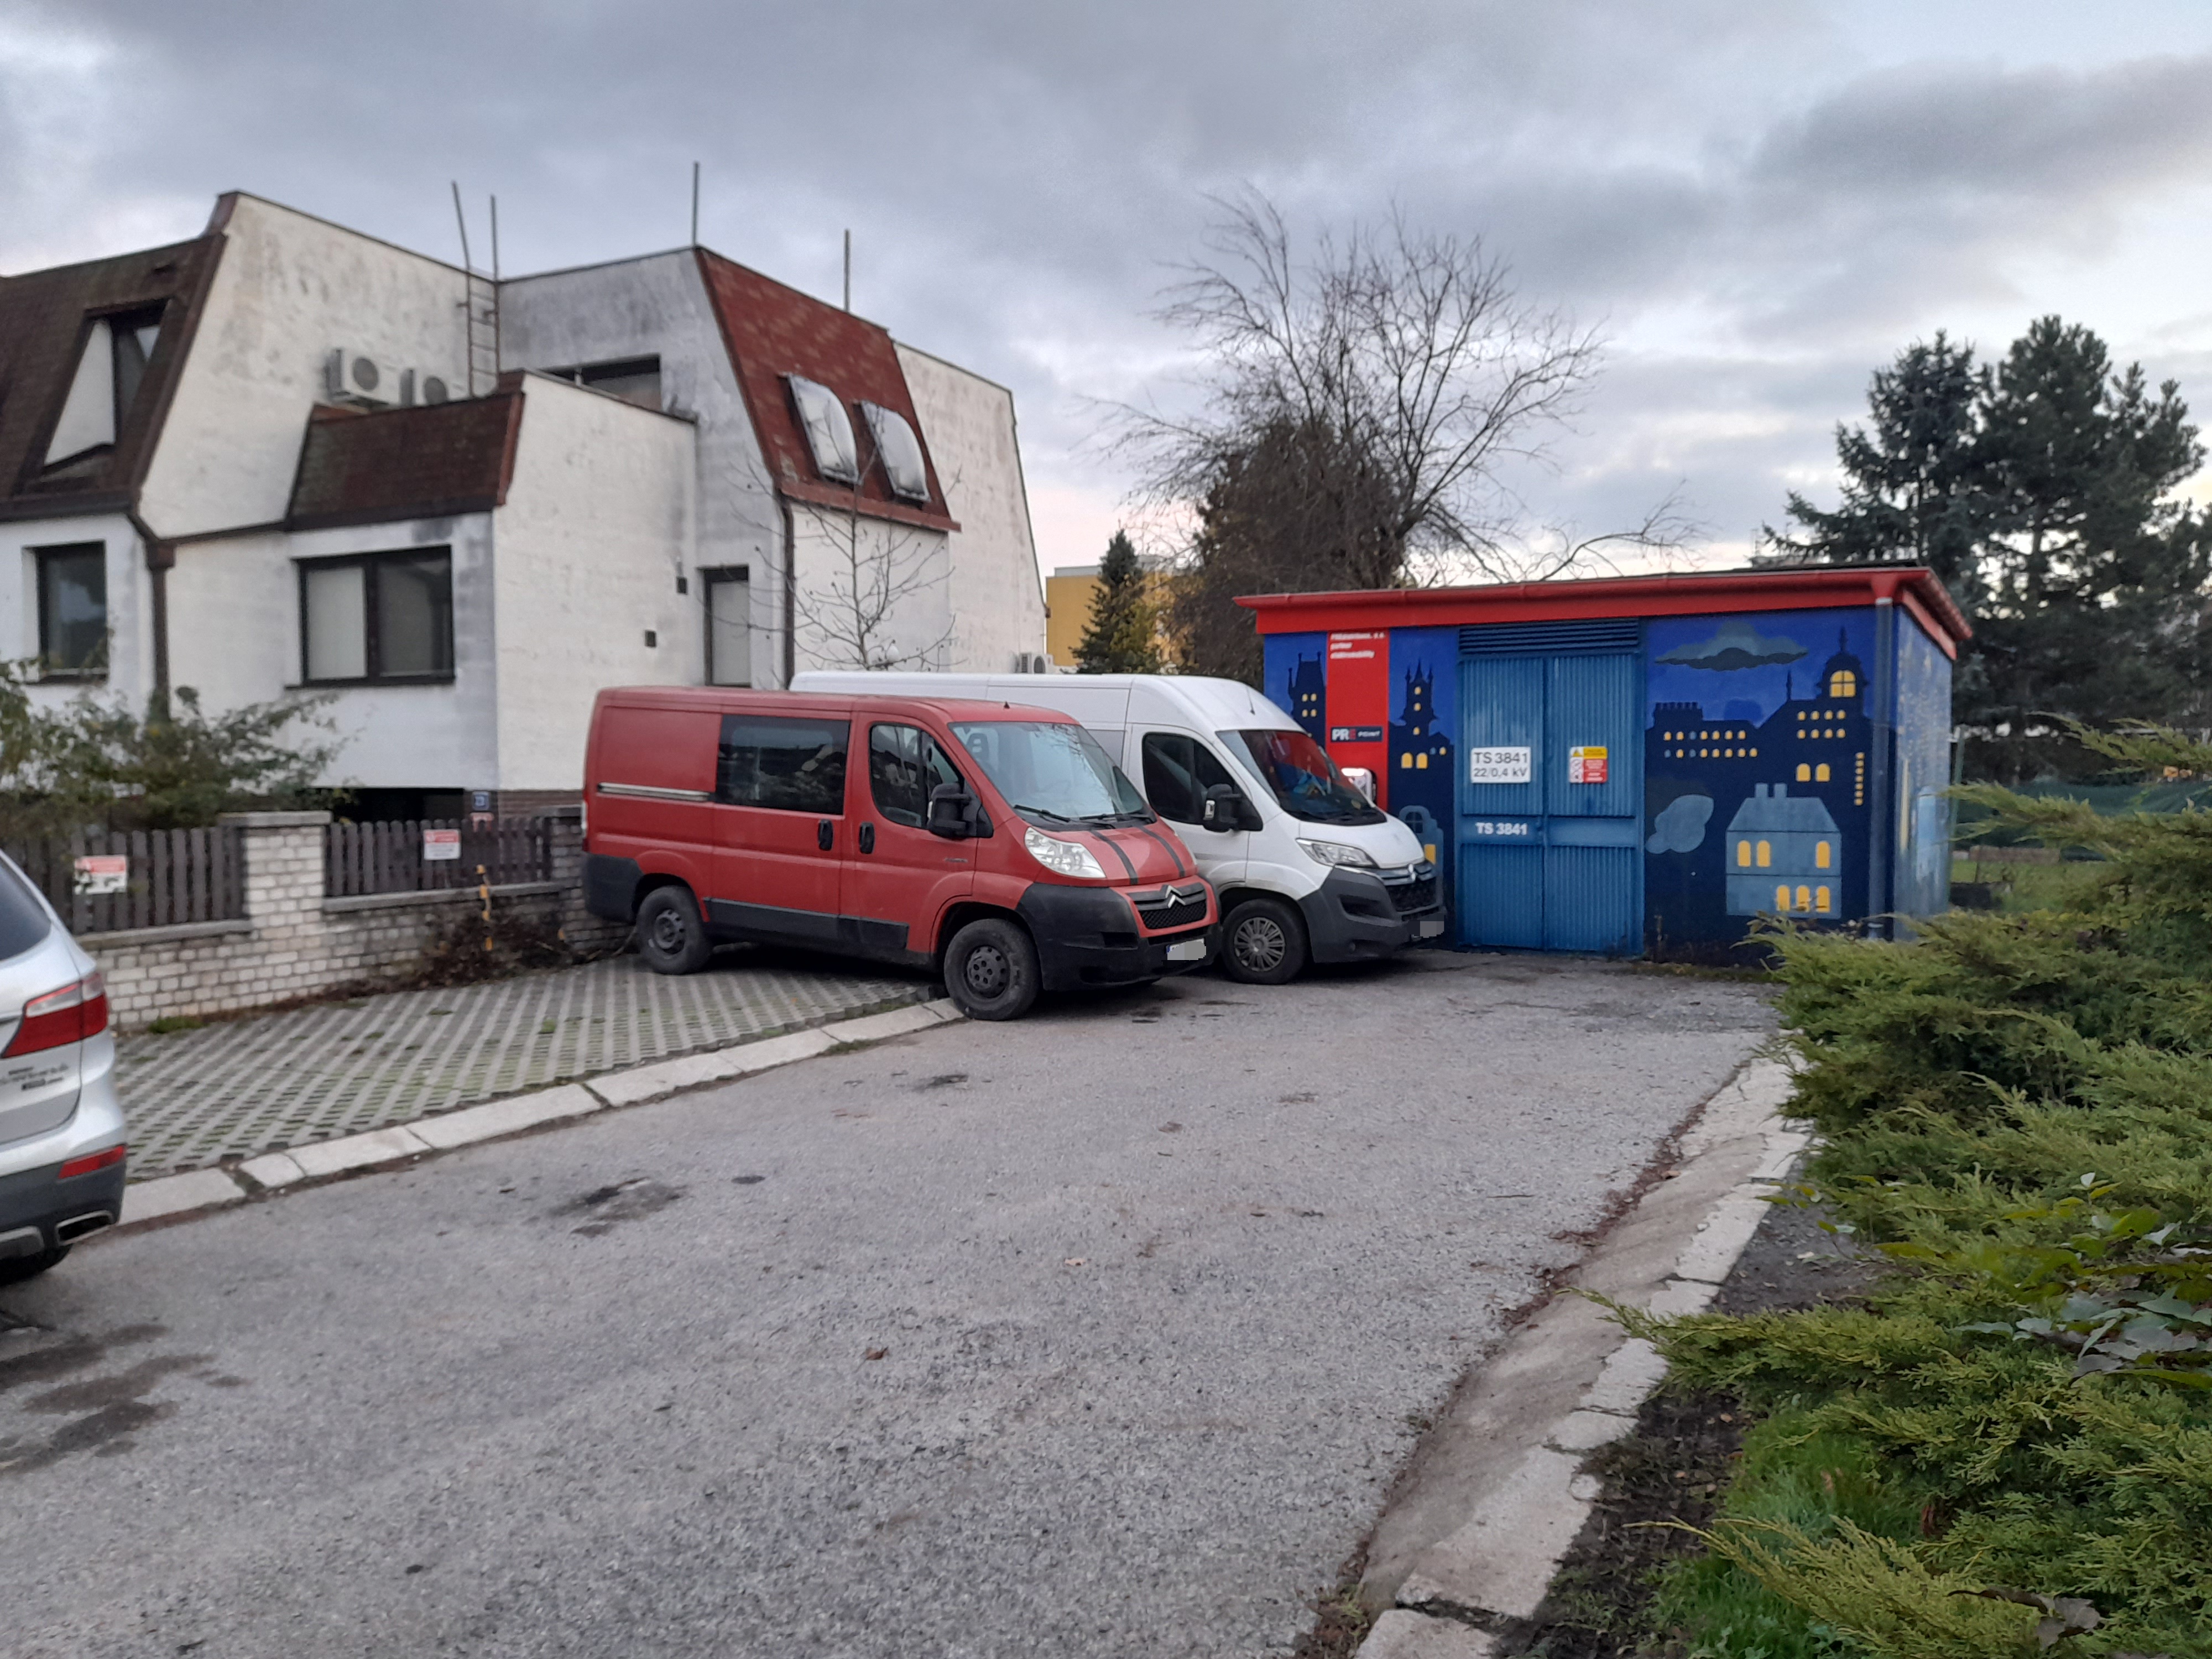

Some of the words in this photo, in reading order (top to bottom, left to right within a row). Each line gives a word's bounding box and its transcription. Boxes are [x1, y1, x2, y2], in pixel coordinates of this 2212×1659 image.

[1474, 752, 1493, 764] TS
[1495, 752, 1527, 764] 3841
[1512, 767, 1527, 777] kV
[1475, 822, 1494, 834] TS
[1496, 822, 1527, 835] 3841
